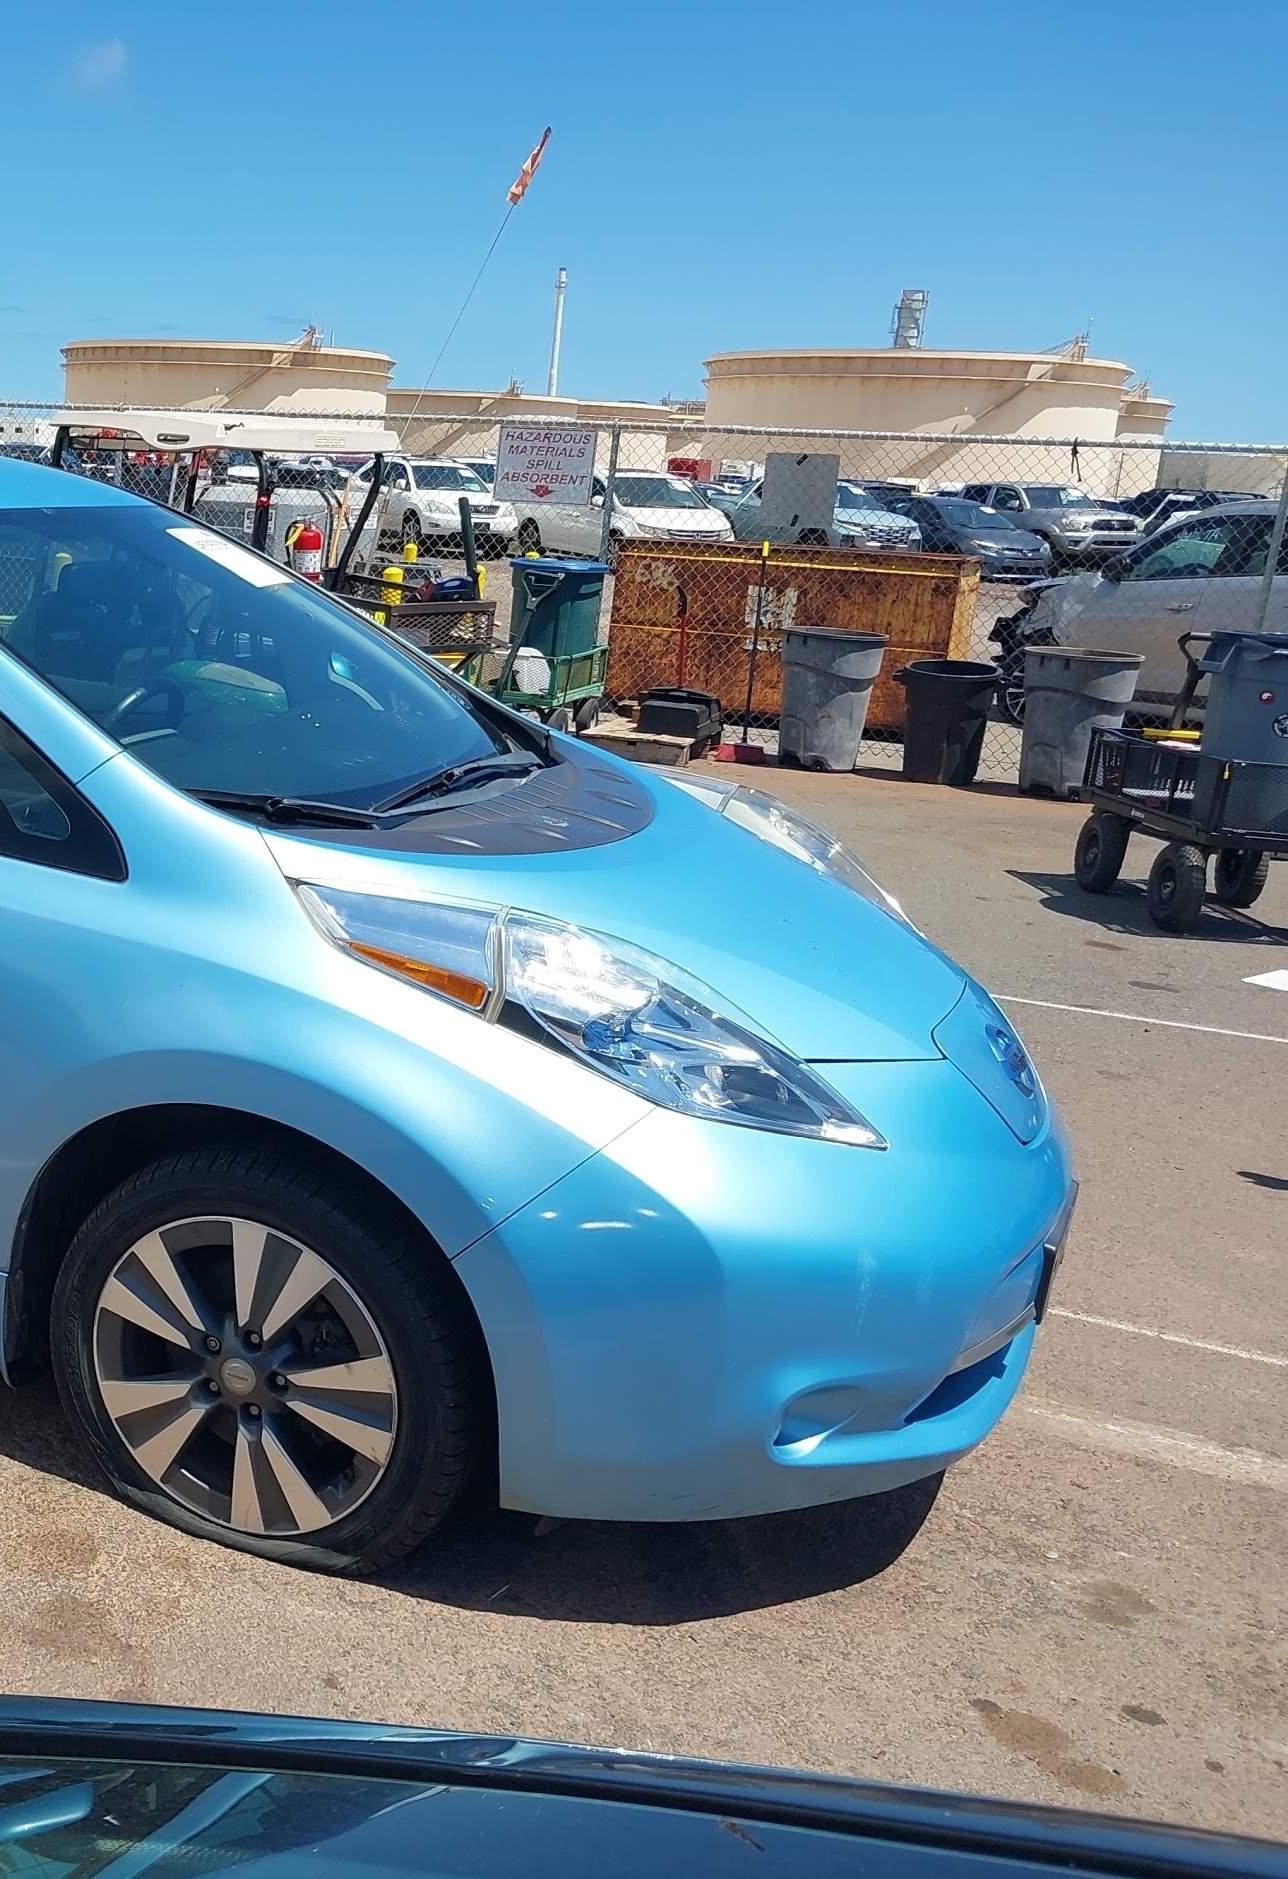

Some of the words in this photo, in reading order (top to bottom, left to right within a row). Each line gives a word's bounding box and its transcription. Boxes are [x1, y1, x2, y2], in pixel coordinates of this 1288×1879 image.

[504, 430, 592, 445] HAZARDOUS
[507, 444, 586, 458] MATERIALS
[526, 459, 564, 471] SPILL
[500, 471, 588, 486] ABSORBENT
